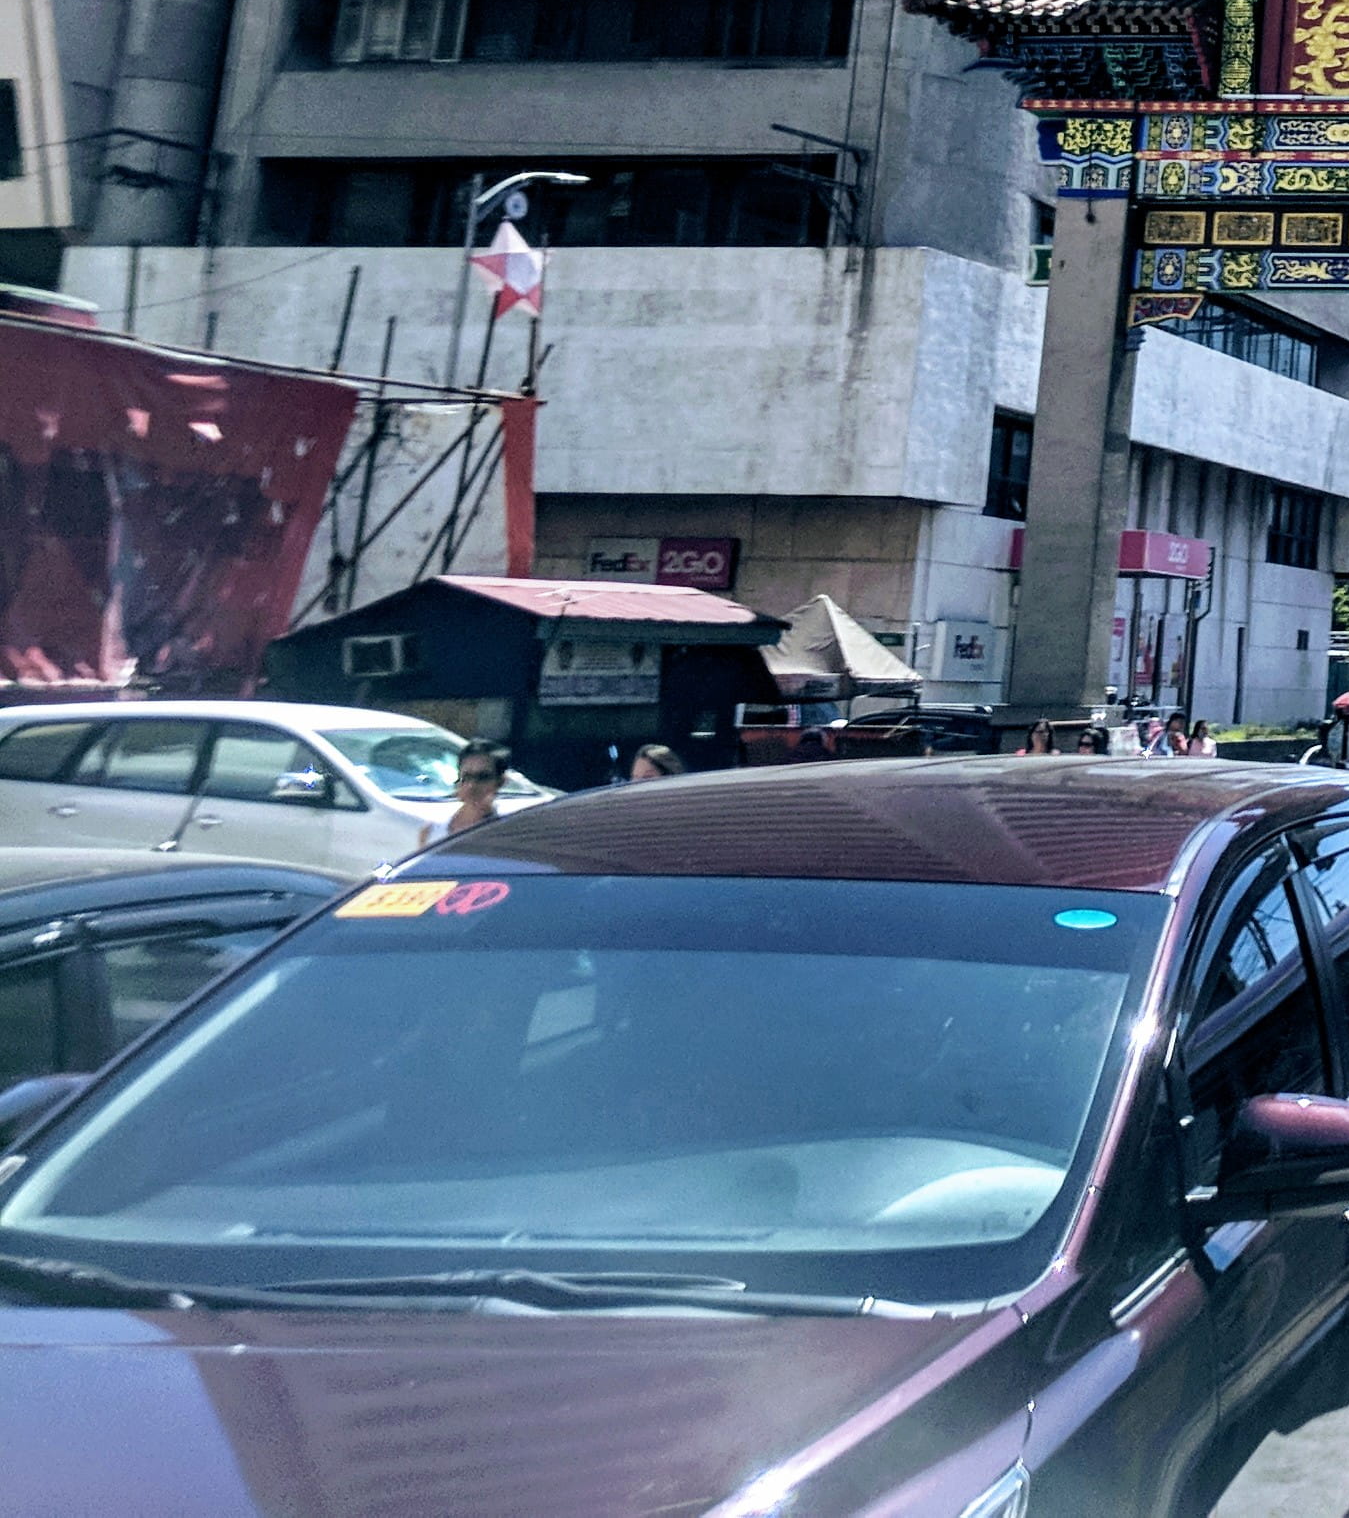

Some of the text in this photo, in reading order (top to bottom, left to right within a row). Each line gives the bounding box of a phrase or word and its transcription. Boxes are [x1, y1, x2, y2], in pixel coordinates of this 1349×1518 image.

[590, 551, 725, 574] FedEx 2GO
[952, 635, 985, 660] FedEx
